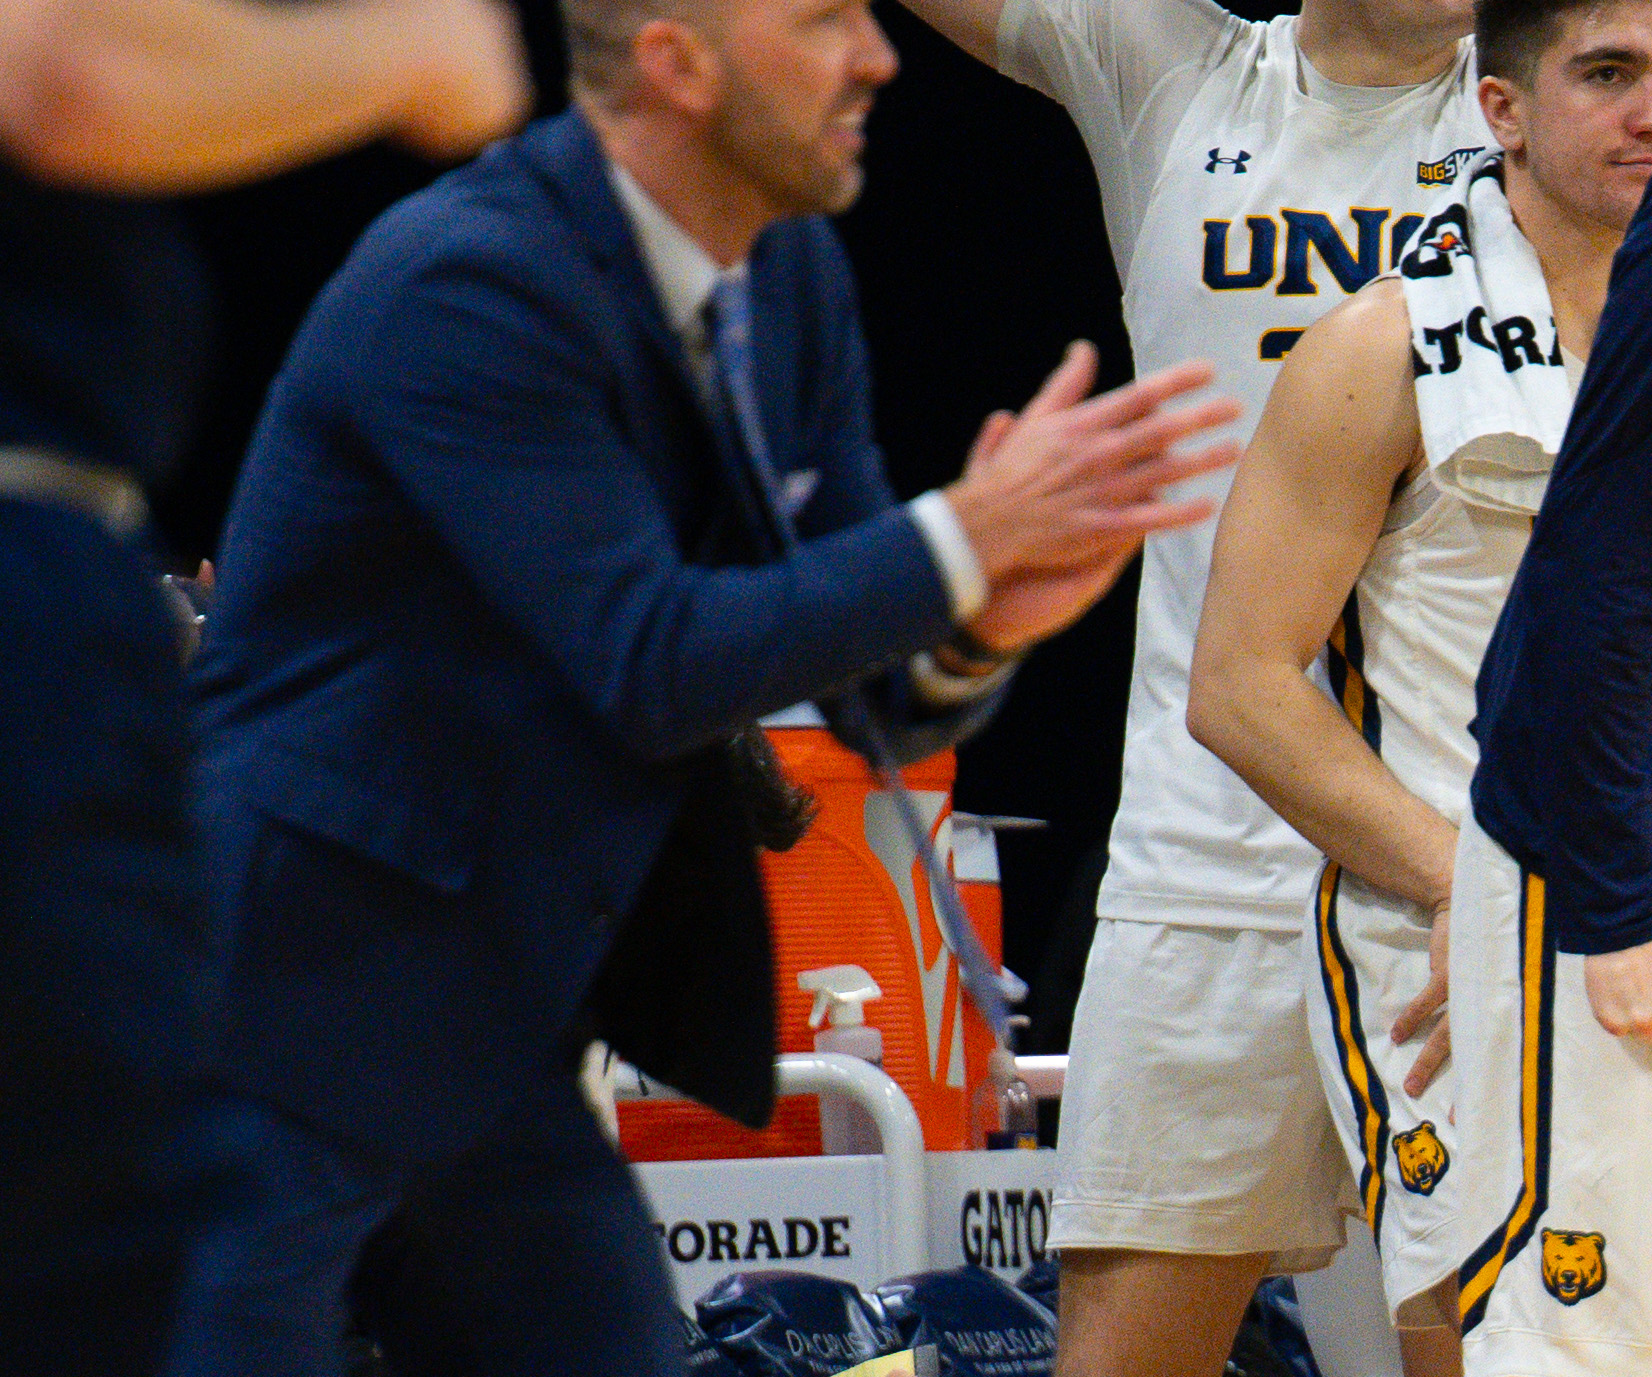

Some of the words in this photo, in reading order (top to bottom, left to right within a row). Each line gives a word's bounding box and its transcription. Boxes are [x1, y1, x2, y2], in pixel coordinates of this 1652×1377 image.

[1419, 163, 1446, 181] BIG
[661, 1216, 850, 1263] ORADE
[961, 1187, 1053, 1268] GATO
